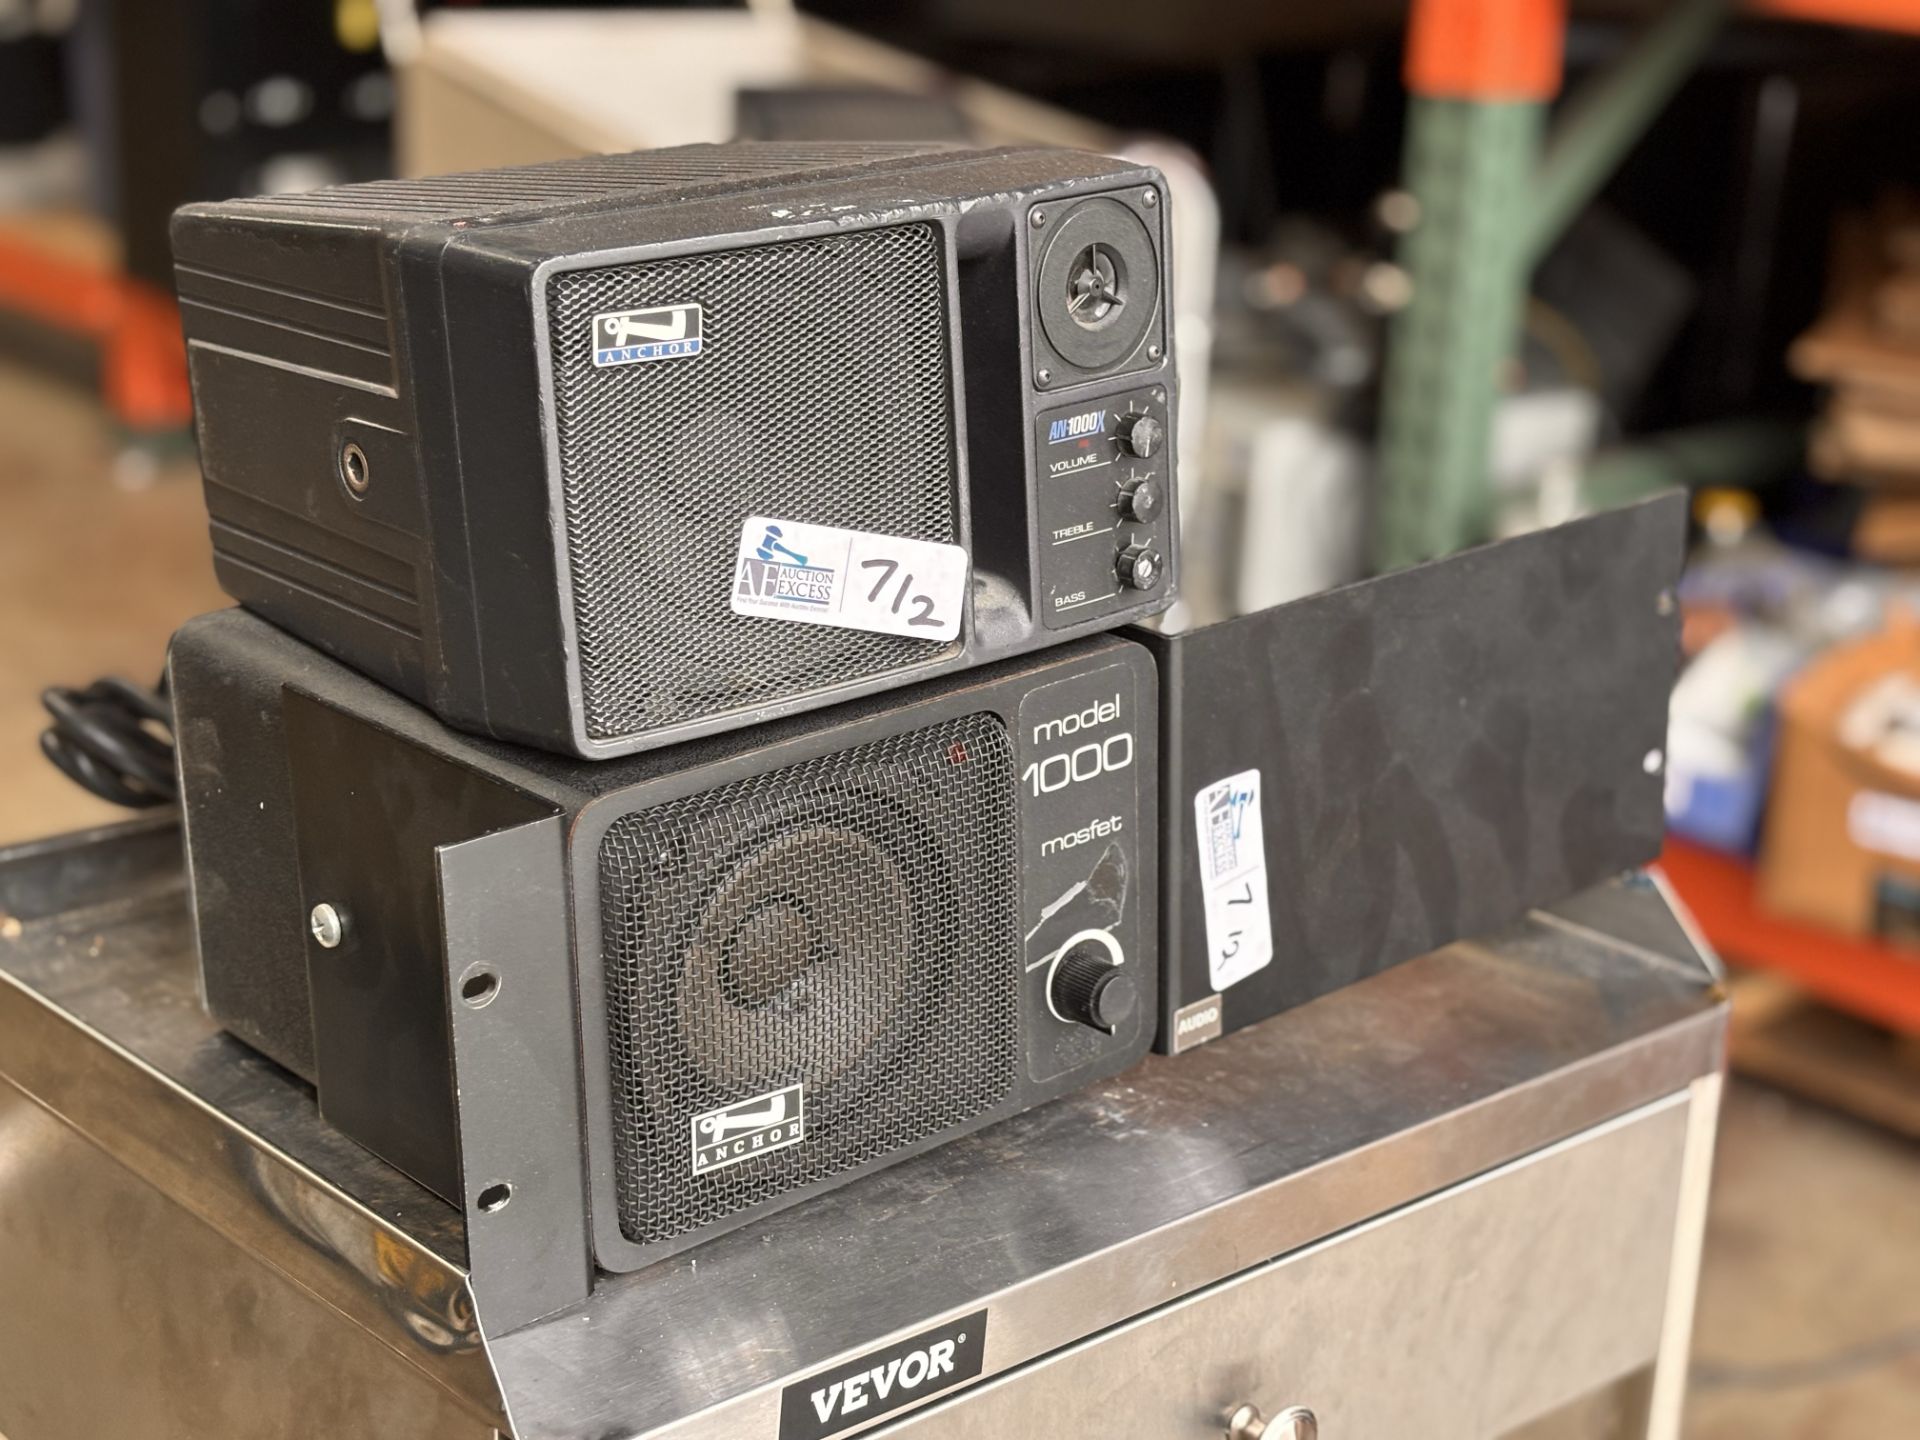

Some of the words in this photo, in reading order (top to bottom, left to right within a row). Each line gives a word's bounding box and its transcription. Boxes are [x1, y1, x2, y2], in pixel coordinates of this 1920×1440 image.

[605, 342, 692, 362] ANCHOR
[1050, 453, 1097, 472] VOLUME
[1053, 521, 1094, 540] TREBLE
[780, 567, 834, 584] AUCTION
[778, 580, 832, 600] EXCESS
[1055, 591, 1086, 607] BASS
[1034, 693, 1120, 744] model
[1022, 732, 1133, 797] 1000
[1041, 815, 1122, 857] mosfet
[1178, 1007, 1218, 1035] AUDIO
[697, 1123, 799, 1167] ANCHOR
